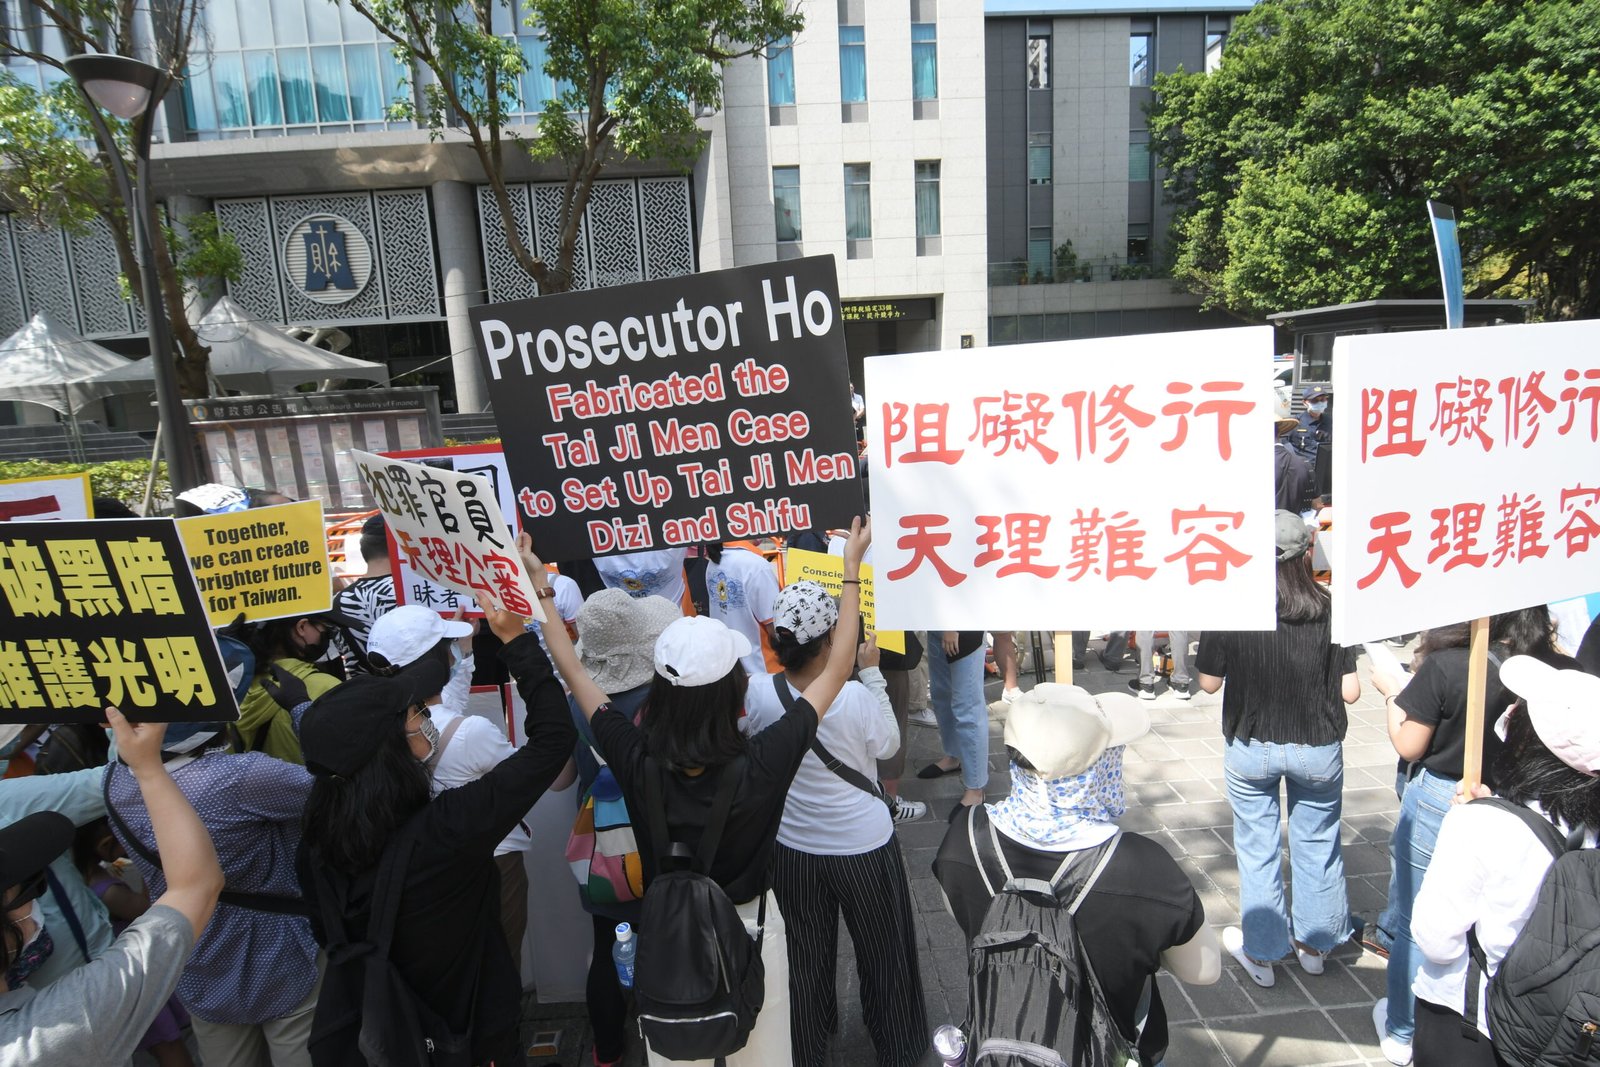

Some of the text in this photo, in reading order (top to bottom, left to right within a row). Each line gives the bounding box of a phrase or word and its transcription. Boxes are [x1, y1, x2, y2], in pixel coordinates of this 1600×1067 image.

[480, 275, 833, 380] Prosecutor Ho
[354, 401, 381, 410] Ministry
[383, 400, 390, 408] of
[391, 399, 419, 407] Finance
[546, 358, 789, 422] Fabricated the
[1361, 369, 1600, 464] 阻礙修行
[543, 408, 809, 469] Tai Ji Men Case
[882, 381, 1256, 468] 阻礙修行
[360, 463, 504, 549] 犯罪官員
[519, 486, 556, 518] to
[562, 477, 619, 513] Set
[624, 469, 672, 507] Up
[677, 459, 733, 497] Tai
[744, 453, 776, 491] Ji
[785, 448, 855, 486] Men
[190, 540, 309, 570] we can create
[204, 521, 288, 546] Together,
[587, 497, 812, 554] Dizi and Shifu
[887, 504, 1253, 588] 天理難容
[1356, 482, 1600, 590] 天理難容
[195, 560, 322, 592] brighter future
[208, 586, 302, 613] for Taiwan.
[396, 528, 533, 618] 天理公審
